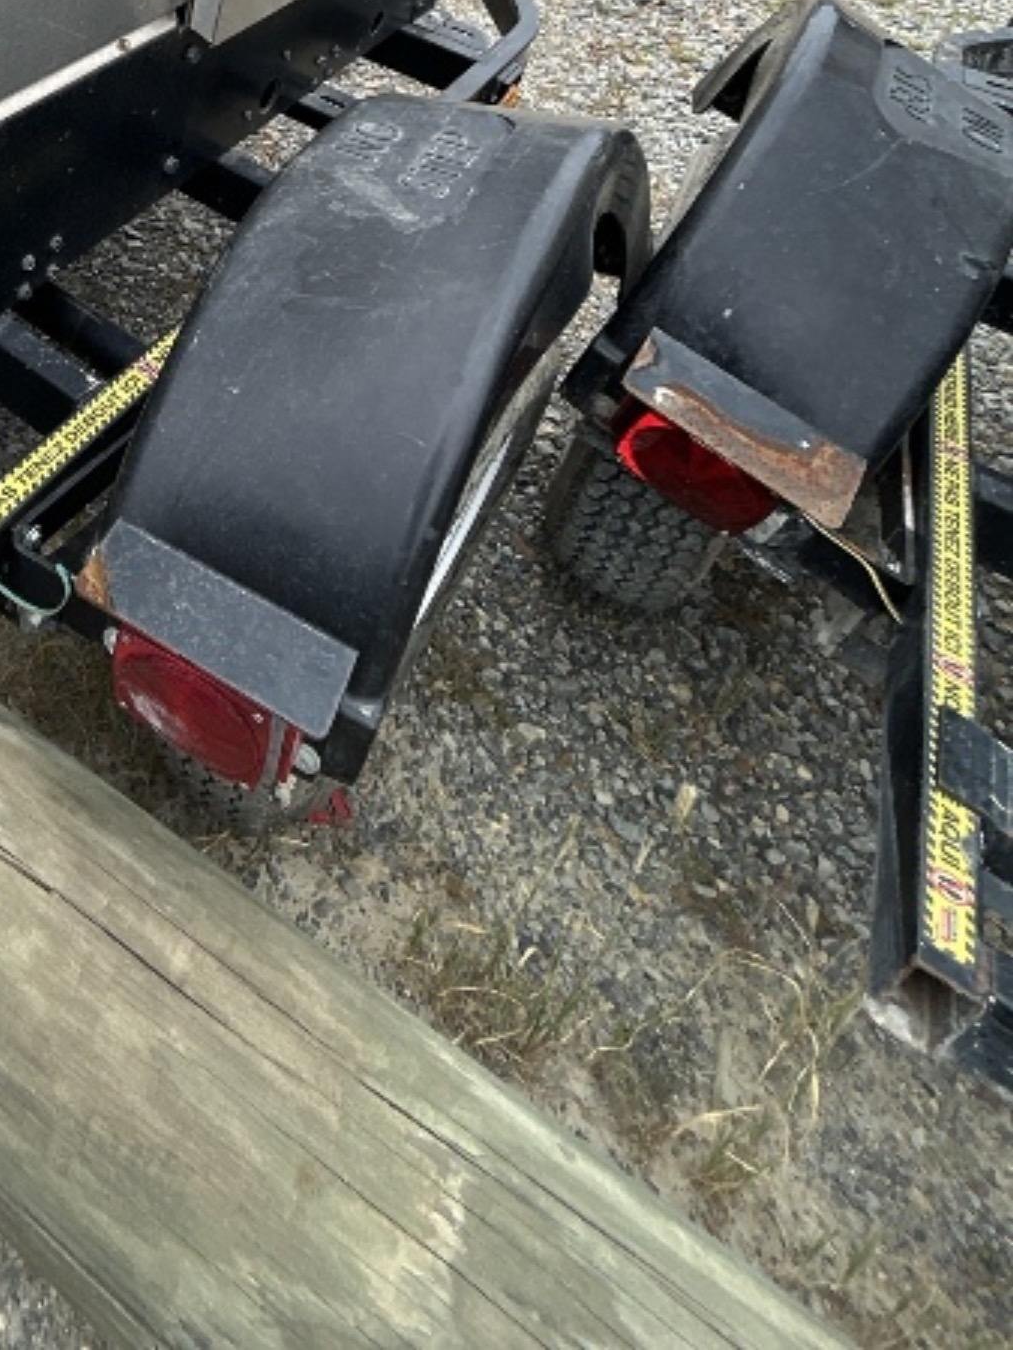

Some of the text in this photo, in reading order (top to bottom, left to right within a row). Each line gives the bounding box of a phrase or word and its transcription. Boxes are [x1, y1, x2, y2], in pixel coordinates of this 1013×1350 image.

[15, 440, 65, 487] TENEZ
[65, 391, 122, 444] DEBOUT
[944, 509, 961, 558] TENEZ
[944, 557, 963, 630] DEBOUT
